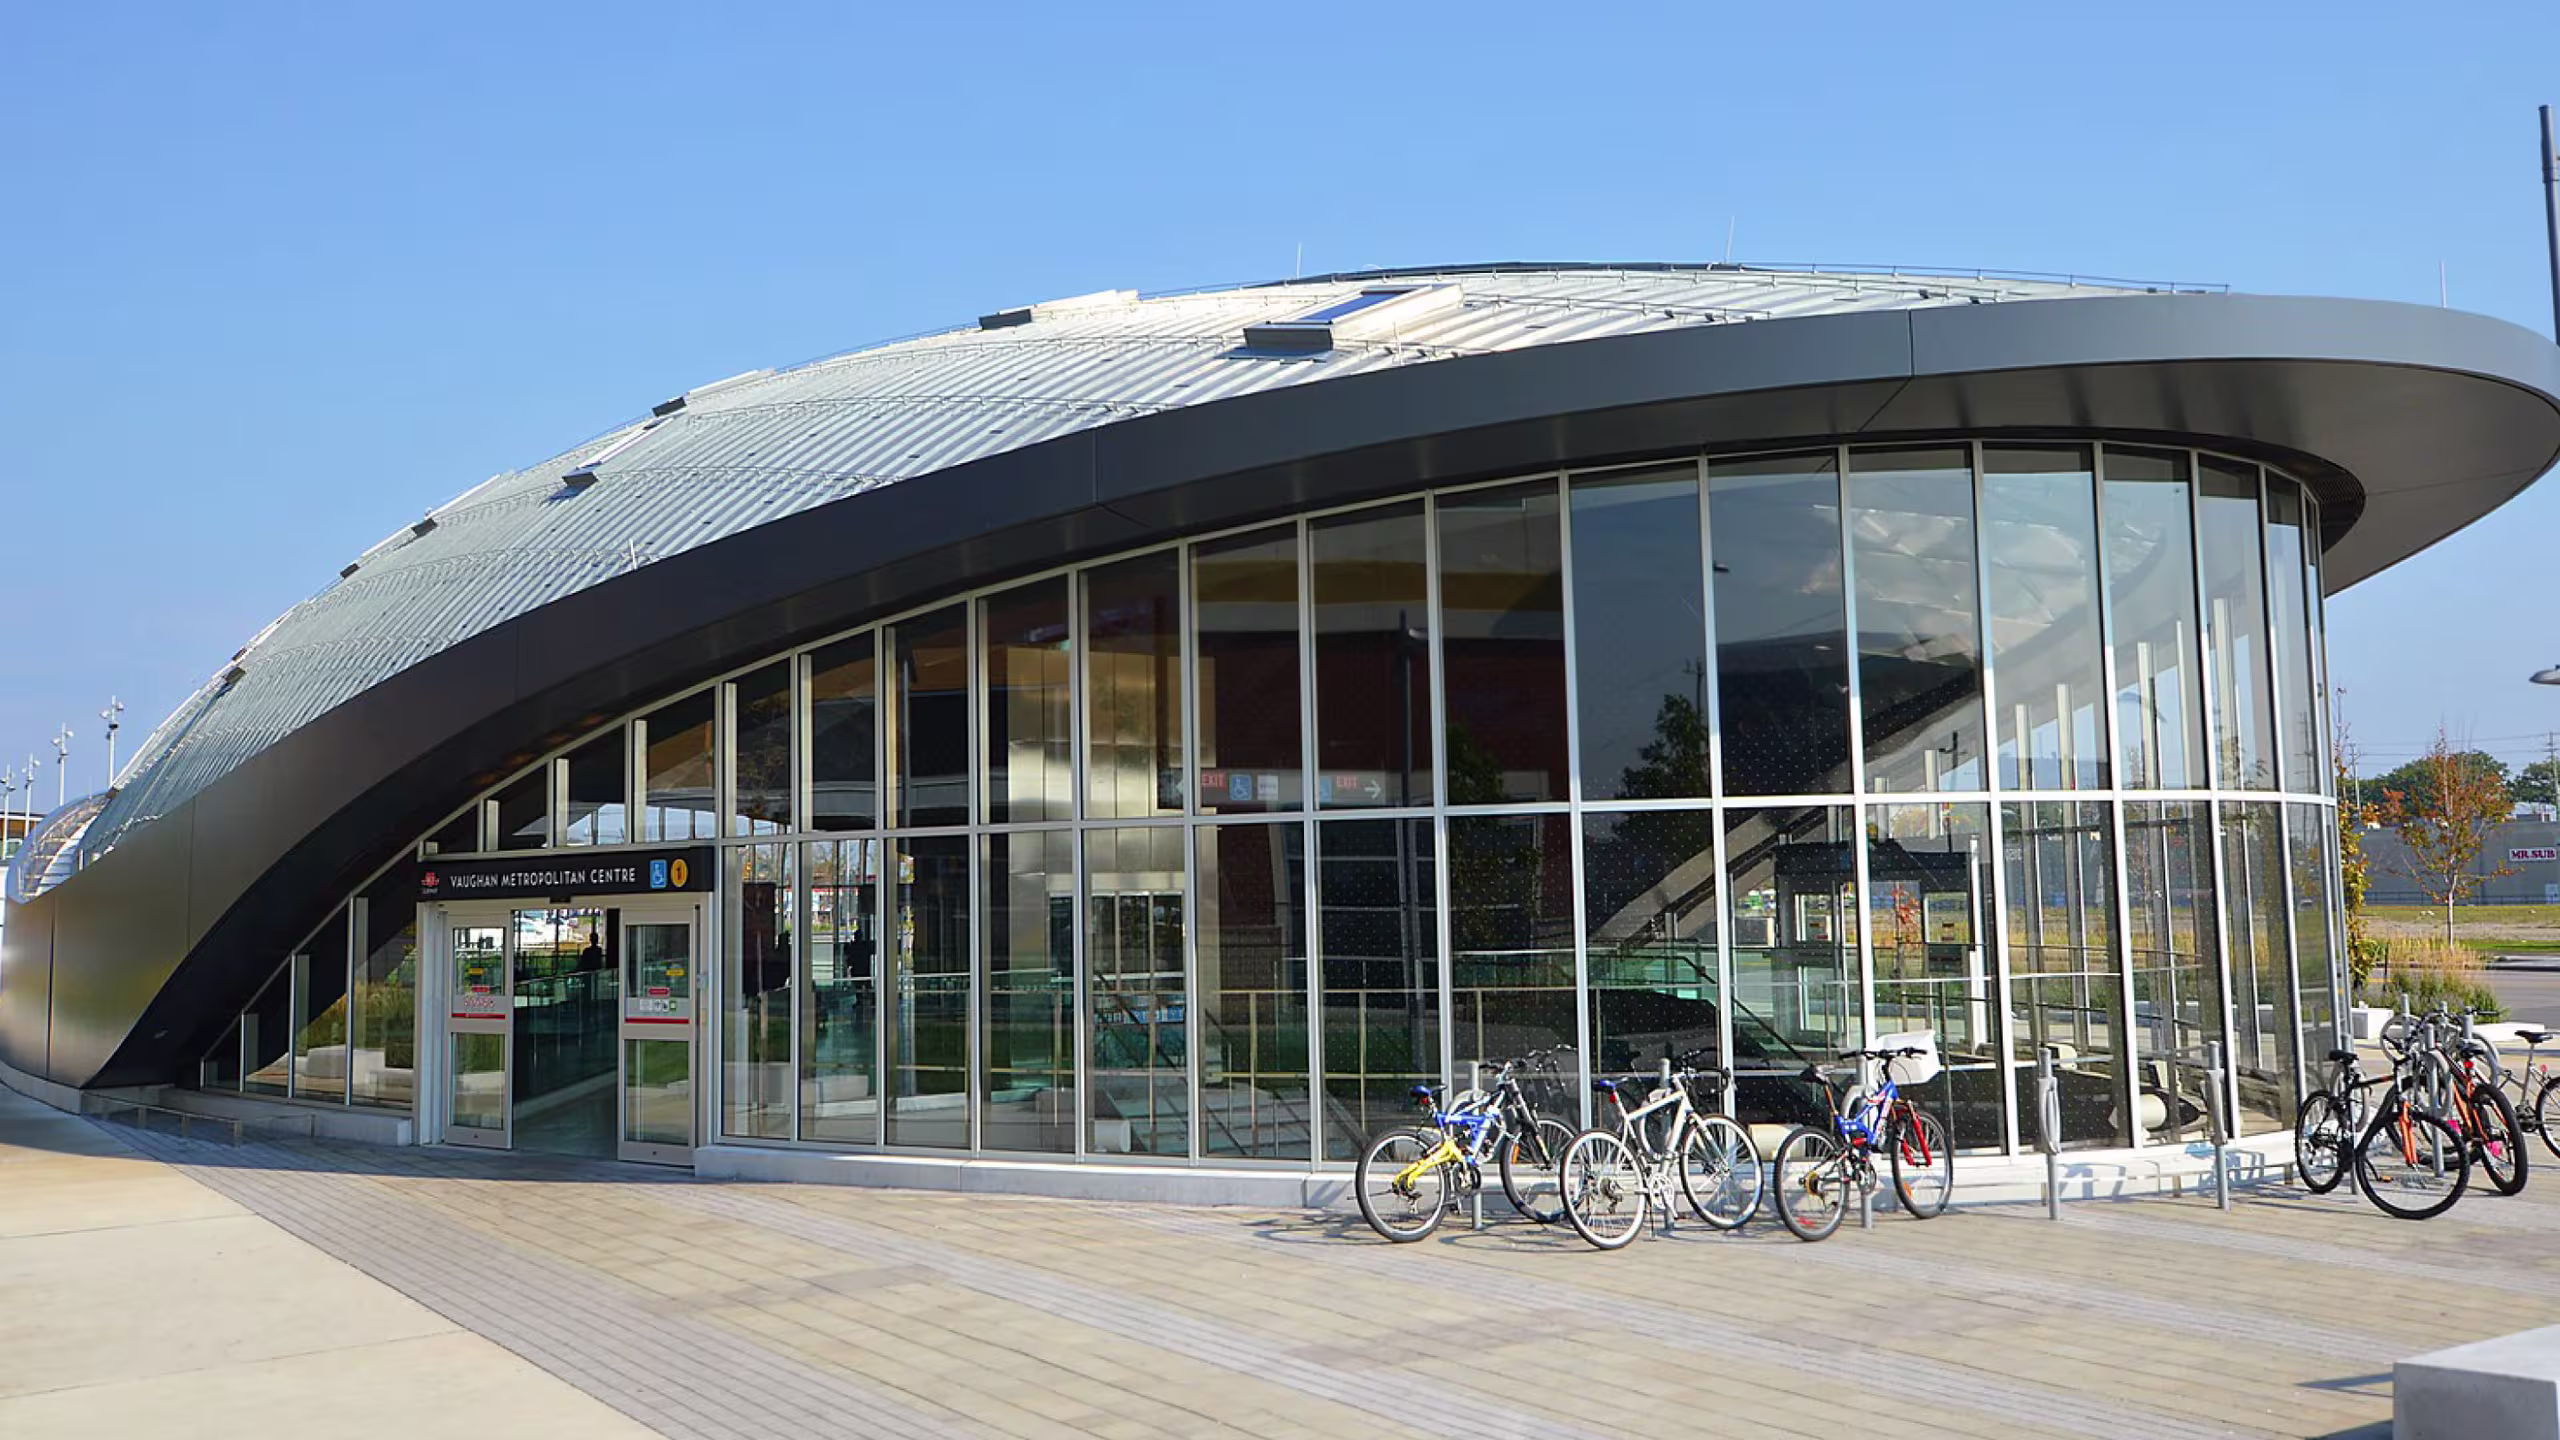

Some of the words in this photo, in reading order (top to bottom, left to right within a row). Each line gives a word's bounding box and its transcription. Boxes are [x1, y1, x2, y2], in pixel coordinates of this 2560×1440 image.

[1201, 774, 1226, 788] EXIT
[449, 873, 499, 888] VAUGHAN
[501, 870, 585, 887] METROPOLITAN
[590, 867, 636, 884] CENTRE
